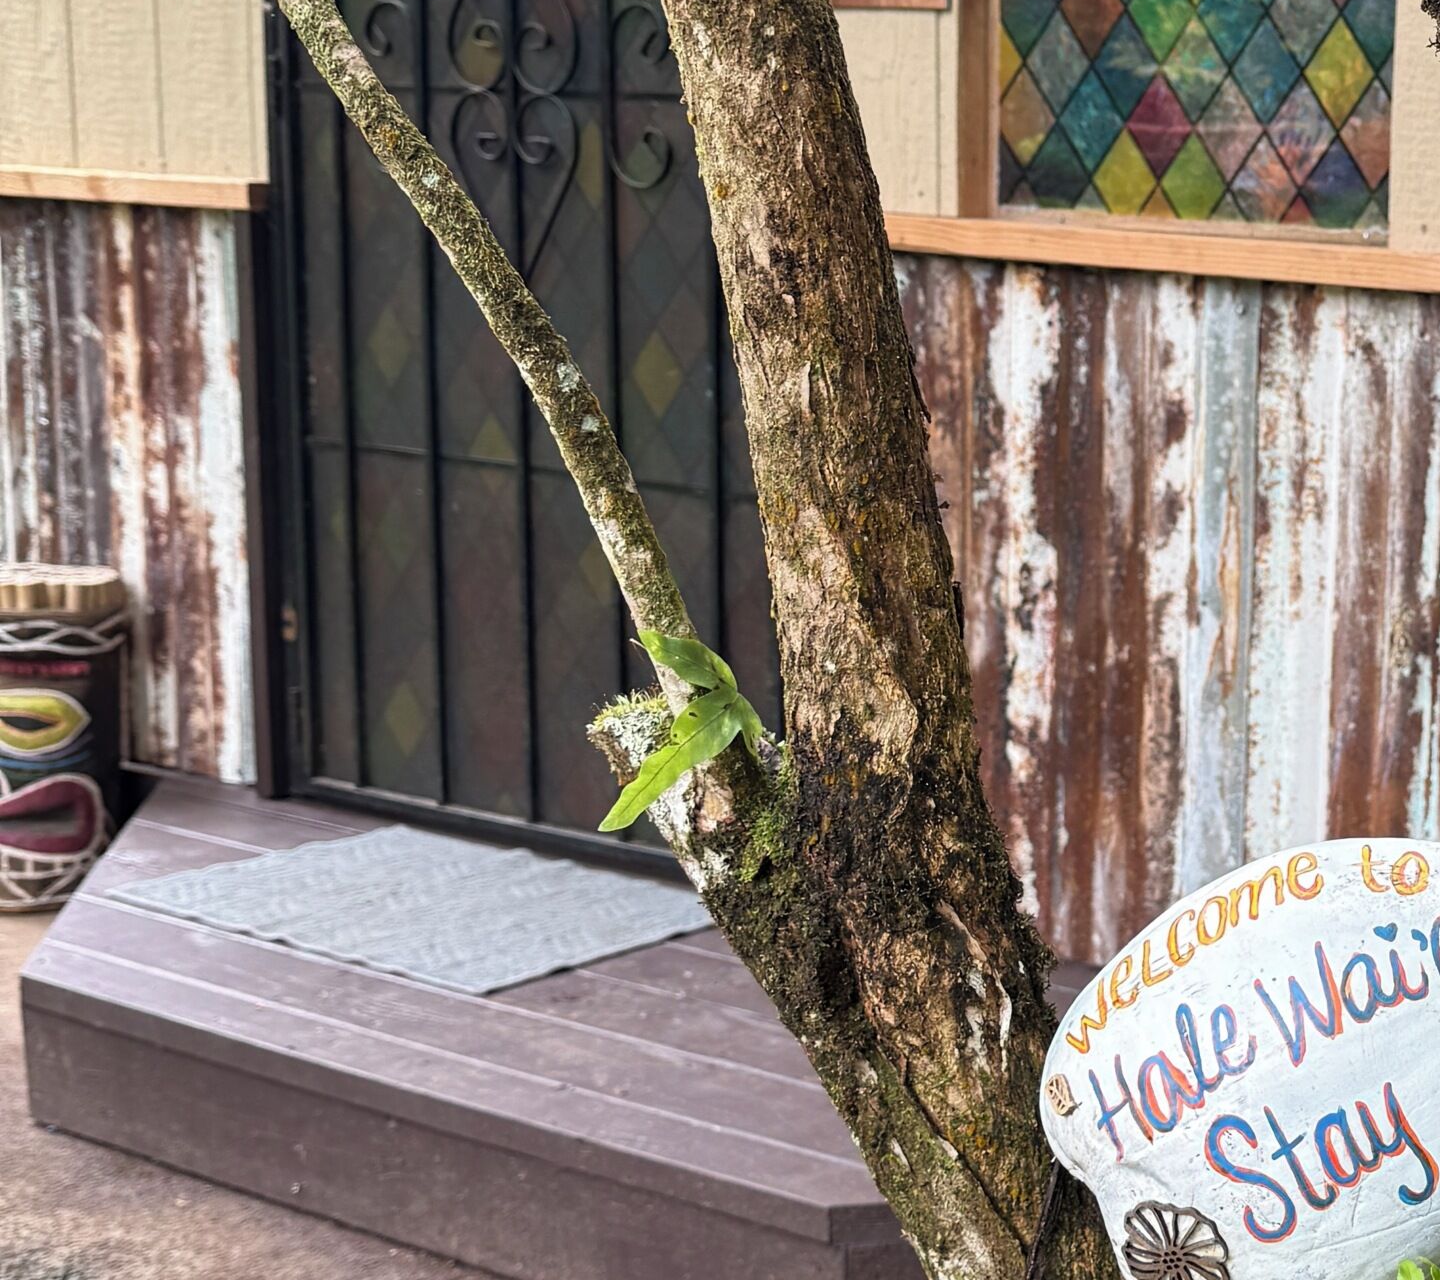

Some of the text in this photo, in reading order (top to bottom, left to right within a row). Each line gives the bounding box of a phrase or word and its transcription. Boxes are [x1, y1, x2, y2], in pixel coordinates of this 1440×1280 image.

[1362, 844, 1430, 895] to
[1088, 1002, 1257, 1163] Hale
[1204, 1082, 1439, 1244] Stay
